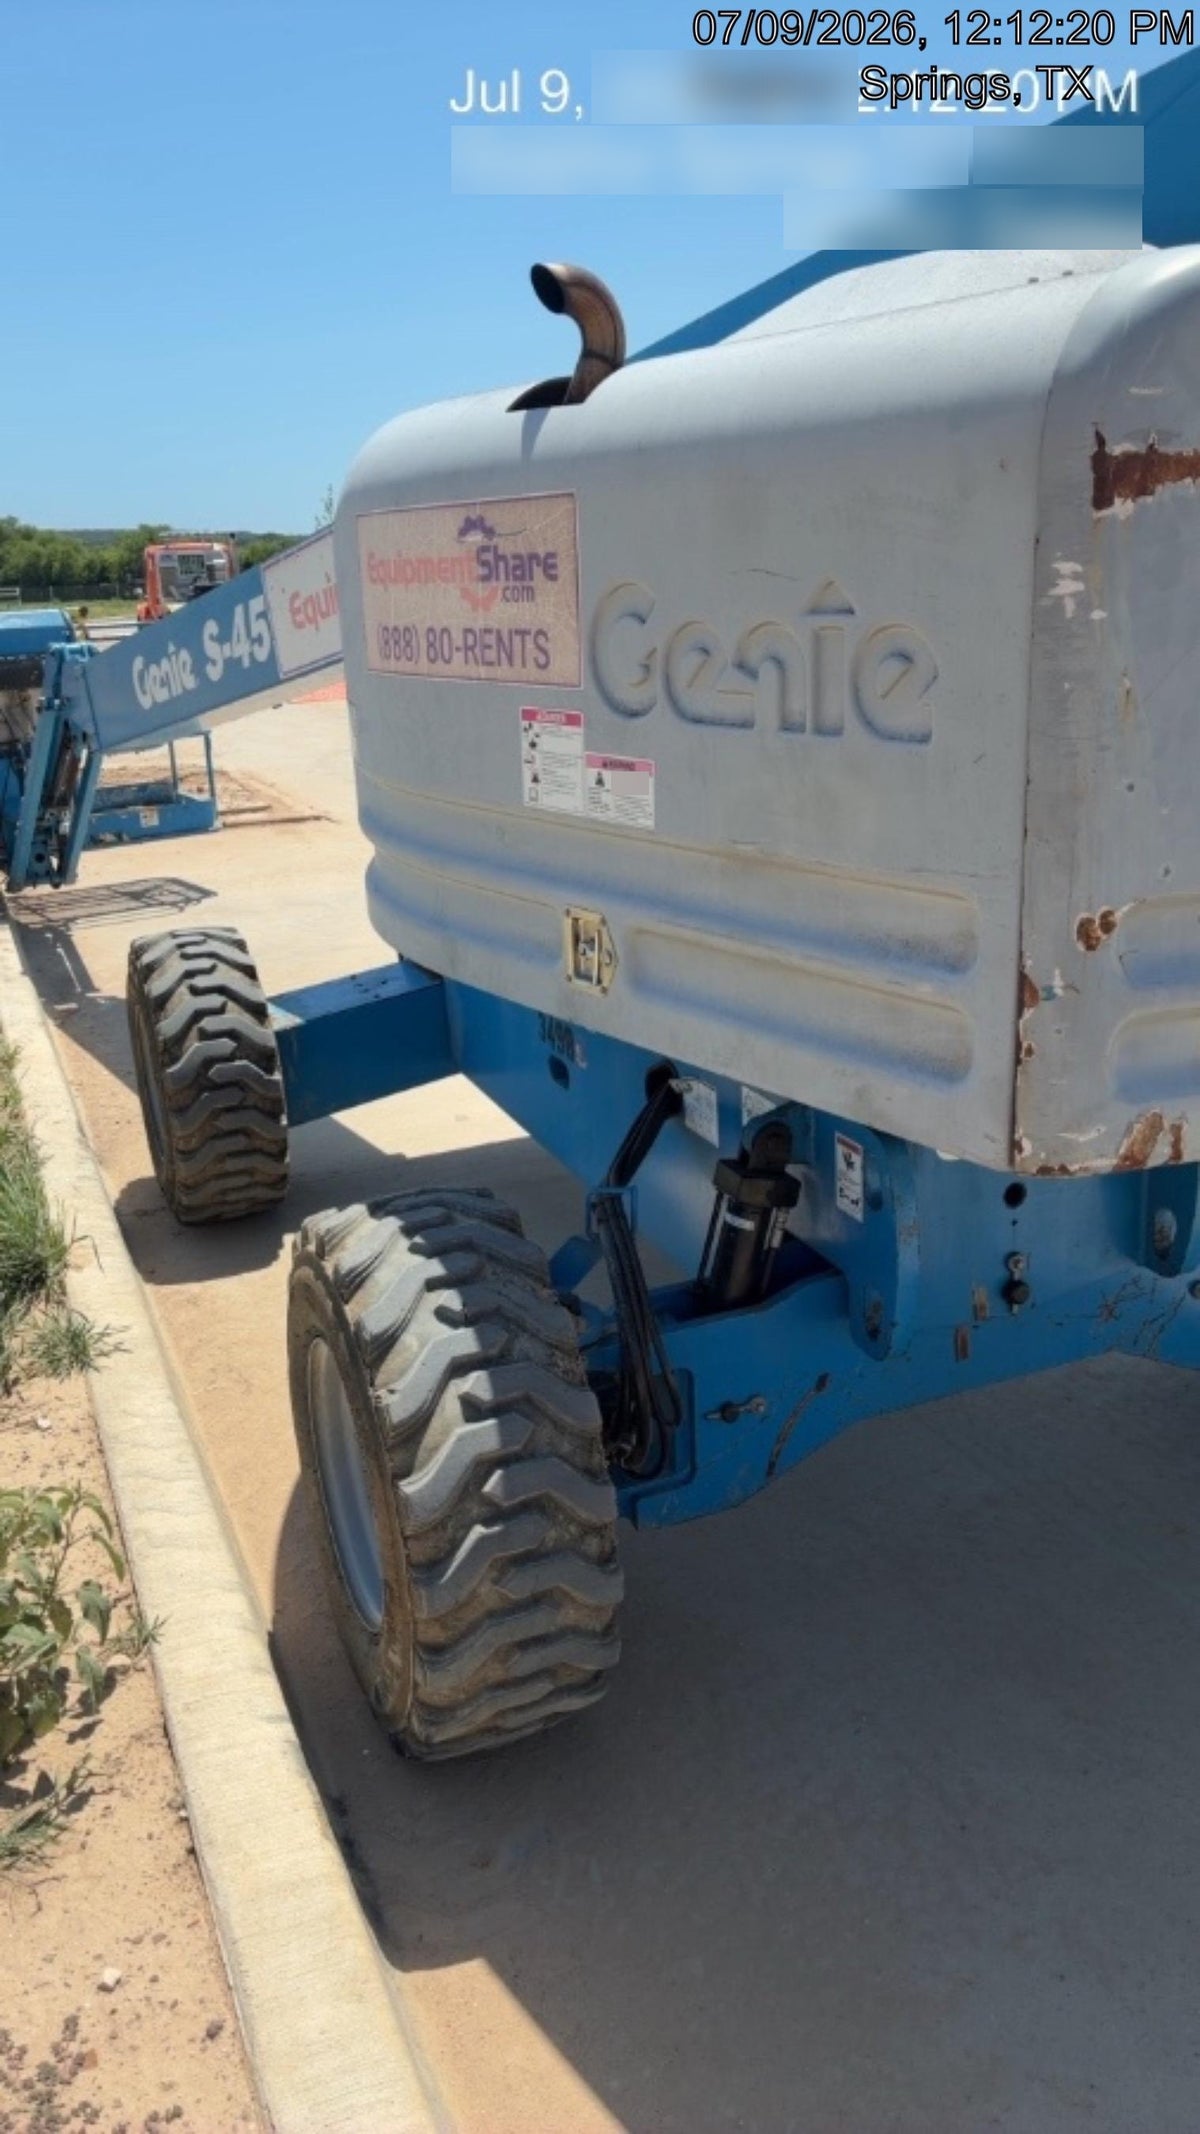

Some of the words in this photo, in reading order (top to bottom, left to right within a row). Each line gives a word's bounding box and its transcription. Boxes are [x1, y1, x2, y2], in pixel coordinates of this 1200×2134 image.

[132, 641, 199, 710] Genie
[203, 595, 272, 682] S-45
[377, 623, 420, 664] (888)
[425, 624, 551, 670] 80-RENTS
[589, 577, 938, 744] Genie
